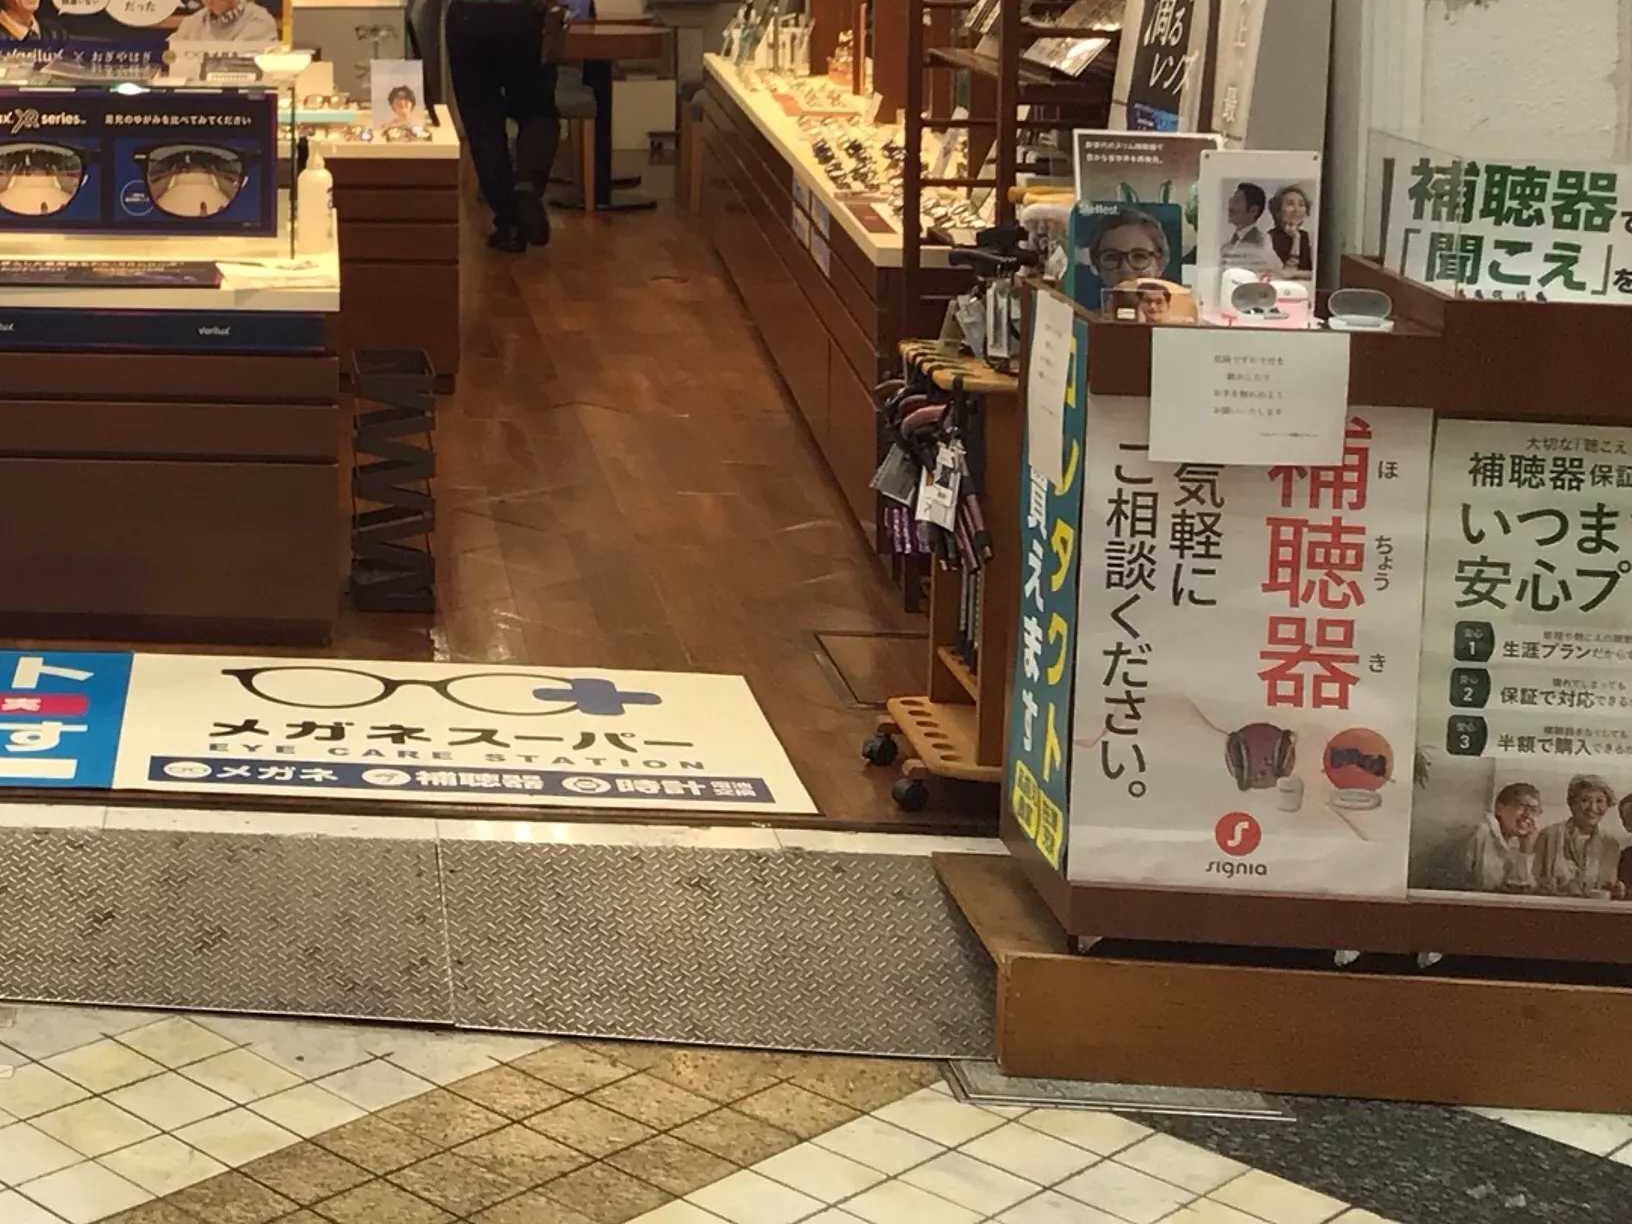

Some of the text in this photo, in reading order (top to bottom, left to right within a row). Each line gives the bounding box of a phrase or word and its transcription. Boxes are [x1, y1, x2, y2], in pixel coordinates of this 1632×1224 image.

[124, 1, 156, 13] だった
[1149, 49, 1199, 96] レンズ
[1377, 459, 1398, 480] ほ
[1461, 502, 1632, 554] いつま
[1373, 535, 1395, 591] ちょう
[1454, 555, 1632, 613] 安心プ
[1468, 641, 1476, 656] 1
[1368, 653, 1387, 675] き
[1463, 687, 1473, 702] 2
[1500, 686, 1632, 709] 保証で対応できる
[209, 719, 694, 753] メガネスーパー
[1459, 734, 1471, 749] 3
[1497, 734, 1632, 757] 半額で購入できる
[209, 742, 705, 770] EYE CARE STATION
[216, 764, 706, 796] メガネ 補聴器 時計
[1205, 859, 1267, 879] signia
